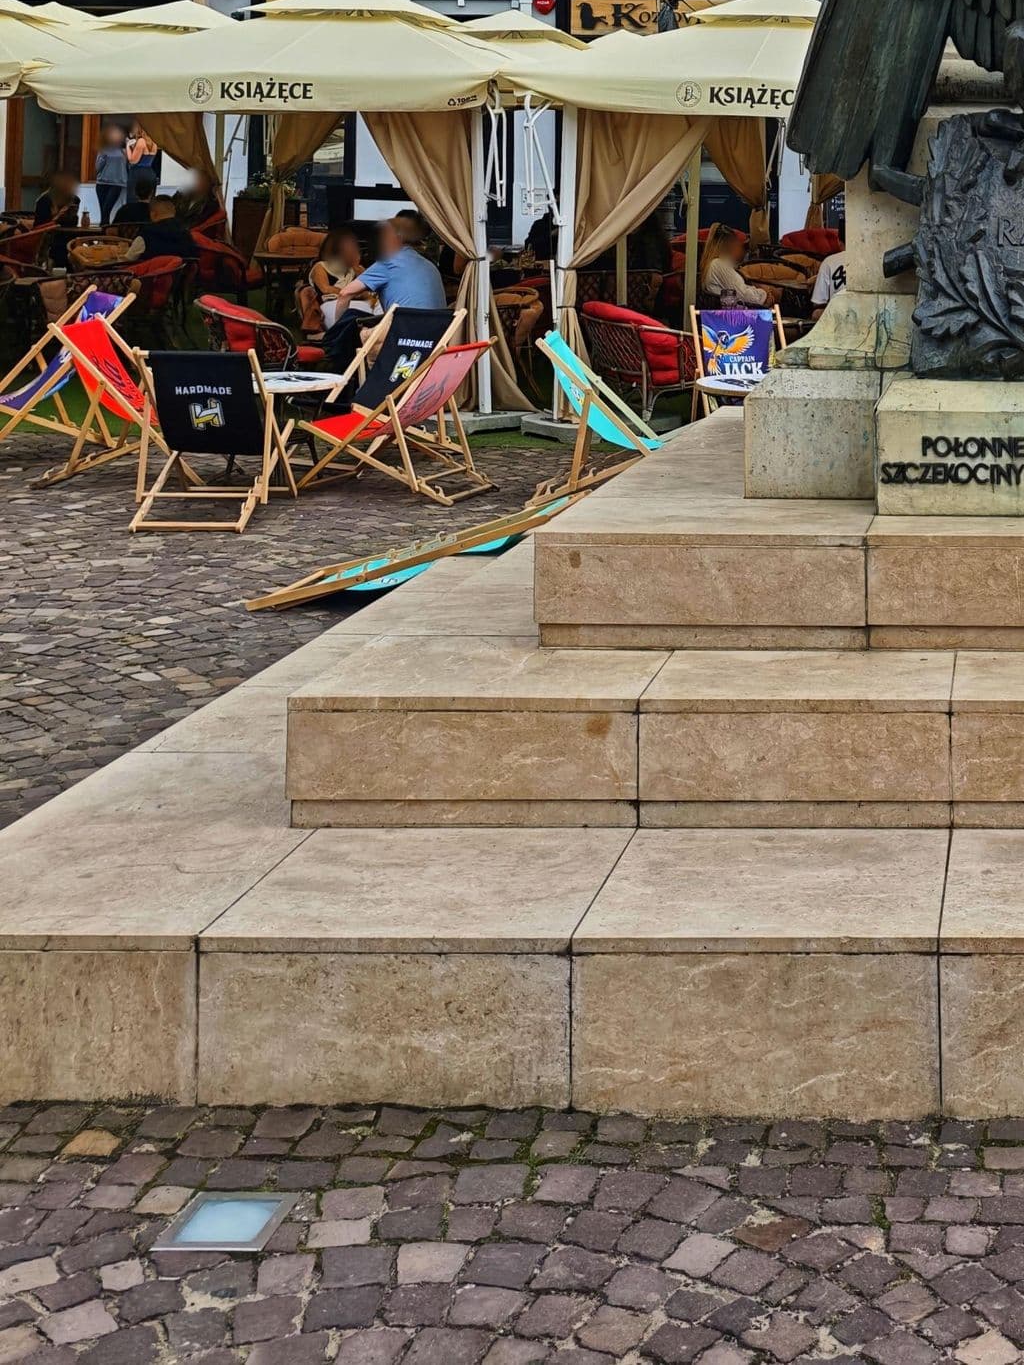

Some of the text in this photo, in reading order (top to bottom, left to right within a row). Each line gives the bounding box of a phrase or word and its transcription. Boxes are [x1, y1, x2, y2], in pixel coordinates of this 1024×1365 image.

[219, 78, 314, 103] KSIĄŻĘCE
[709, 84, 798, 109] KSIĄŻĘC
[397, 338, 434, 348] HARDMADE
[729, 355, 755, 363] CAPTAIN
[723, 362, 763, 376] JACK
[175, 385, 232, 395] HARDMADE
